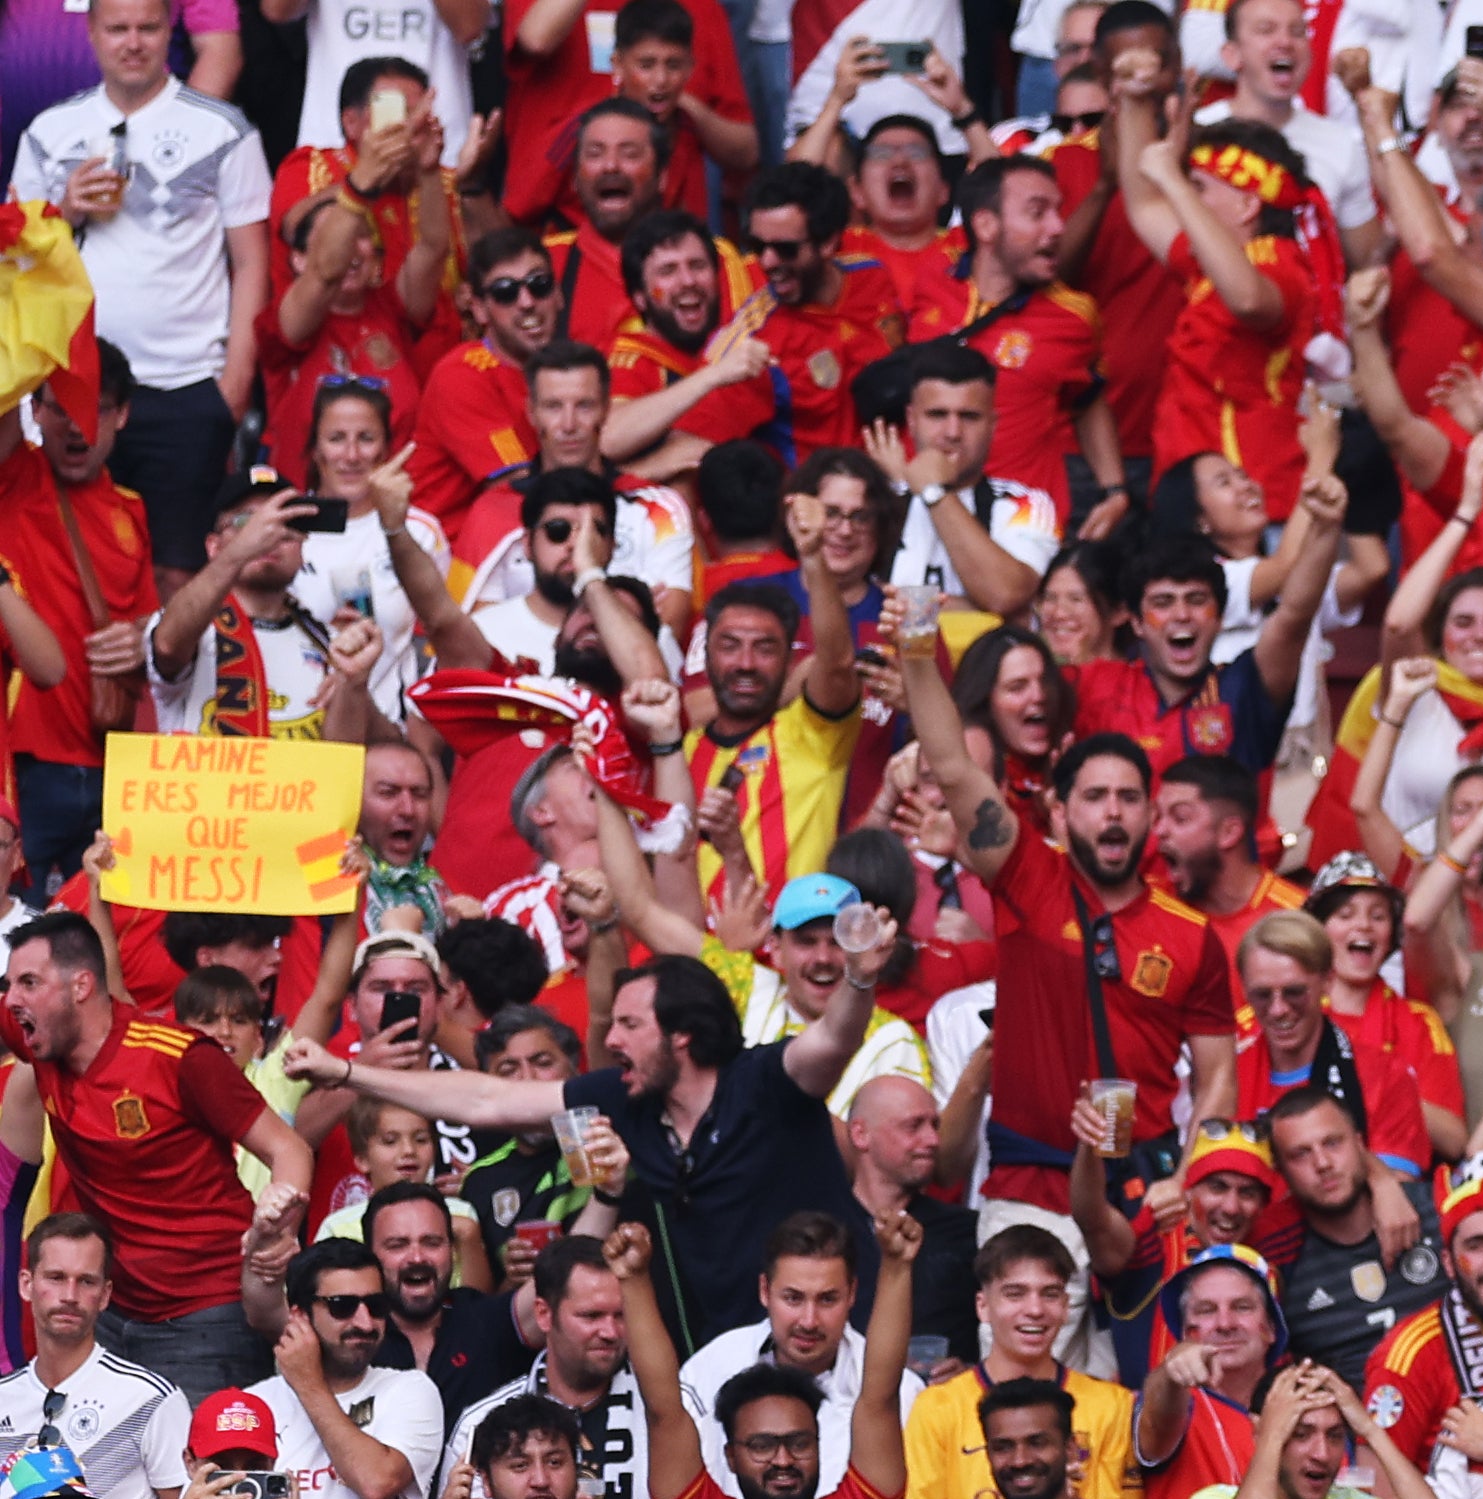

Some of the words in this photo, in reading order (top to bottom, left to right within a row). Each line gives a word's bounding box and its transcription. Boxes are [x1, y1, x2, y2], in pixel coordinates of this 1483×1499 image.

[344, 6, 427, 42] GER
[149, 740, 268, 775] LAMINE
[121, 781, 199, 812] ERES
[226, 780, 317, 814] MEJOR
[186, 816, 250, 852] QUE
[149, 855, 264, 904] MESSI
